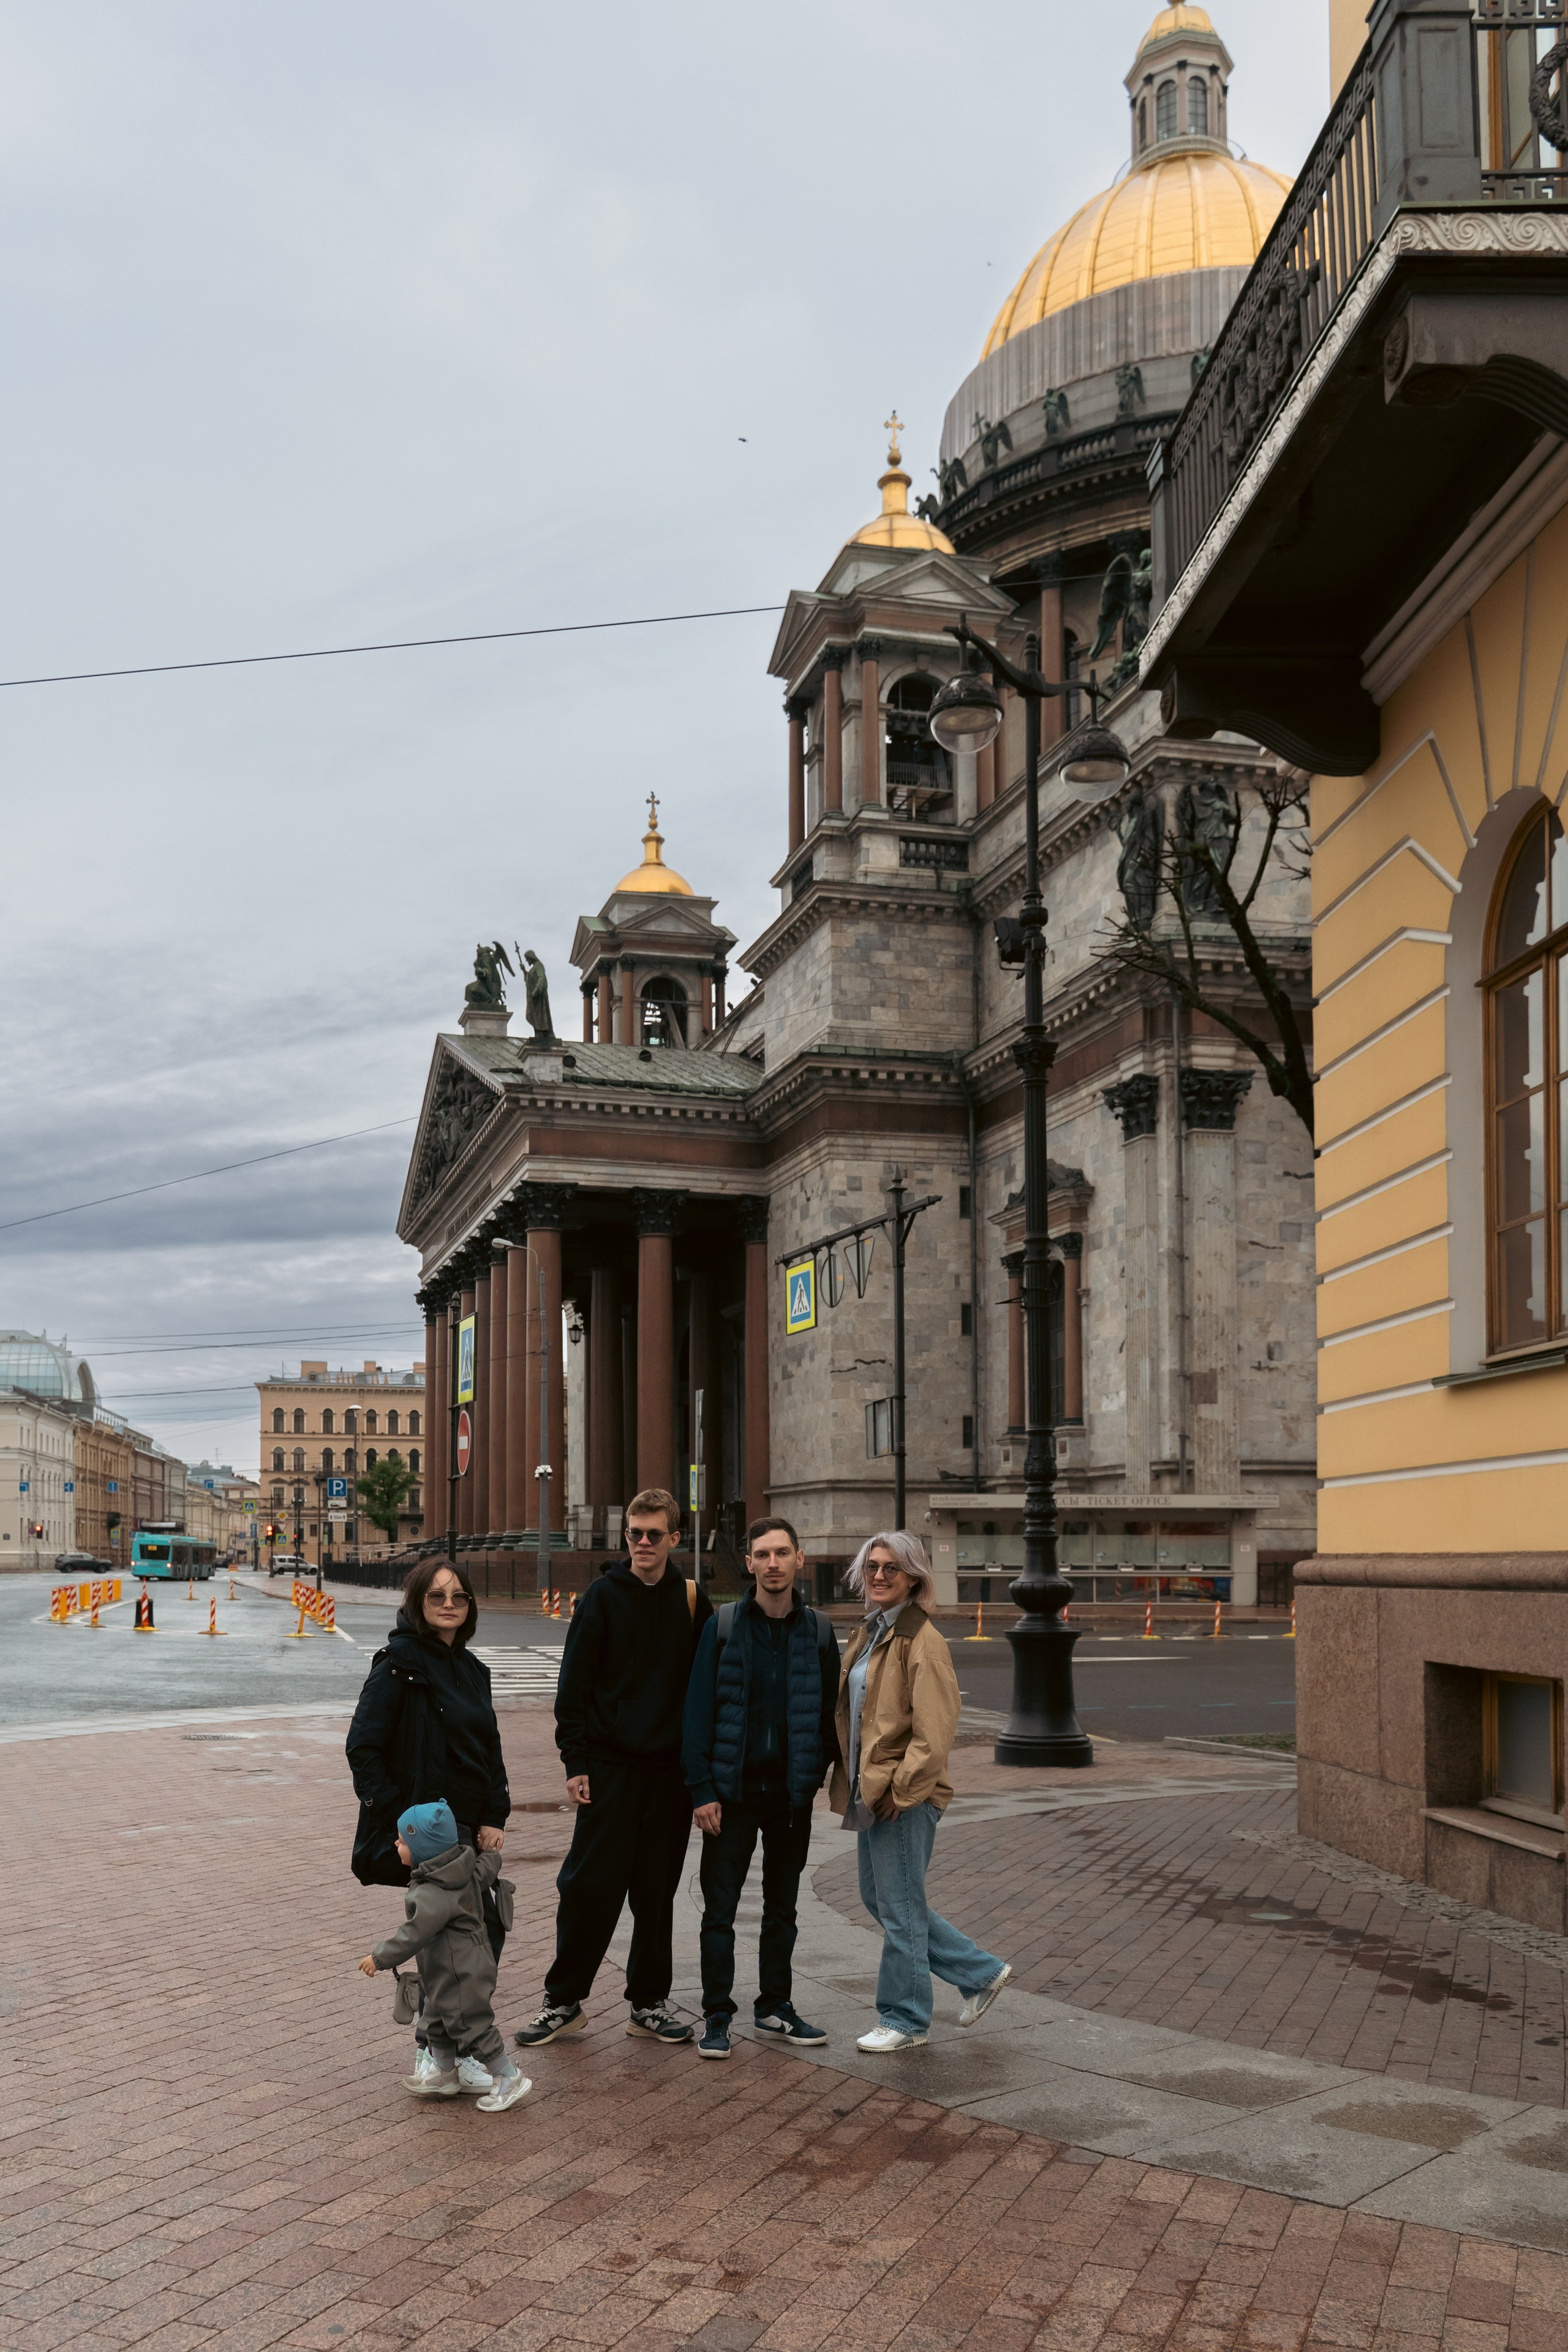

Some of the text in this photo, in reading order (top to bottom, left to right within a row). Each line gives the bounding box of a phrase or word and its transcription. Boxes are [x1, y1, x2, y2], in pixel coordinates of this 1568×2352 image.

[333, 1480, 344, 1496] P
[1056, 1496, 1079, 1506] ССЫ
[1087, 1496, 1172, 1506] TICKET OFFICE
[644, 2017, 660, 2030] N
